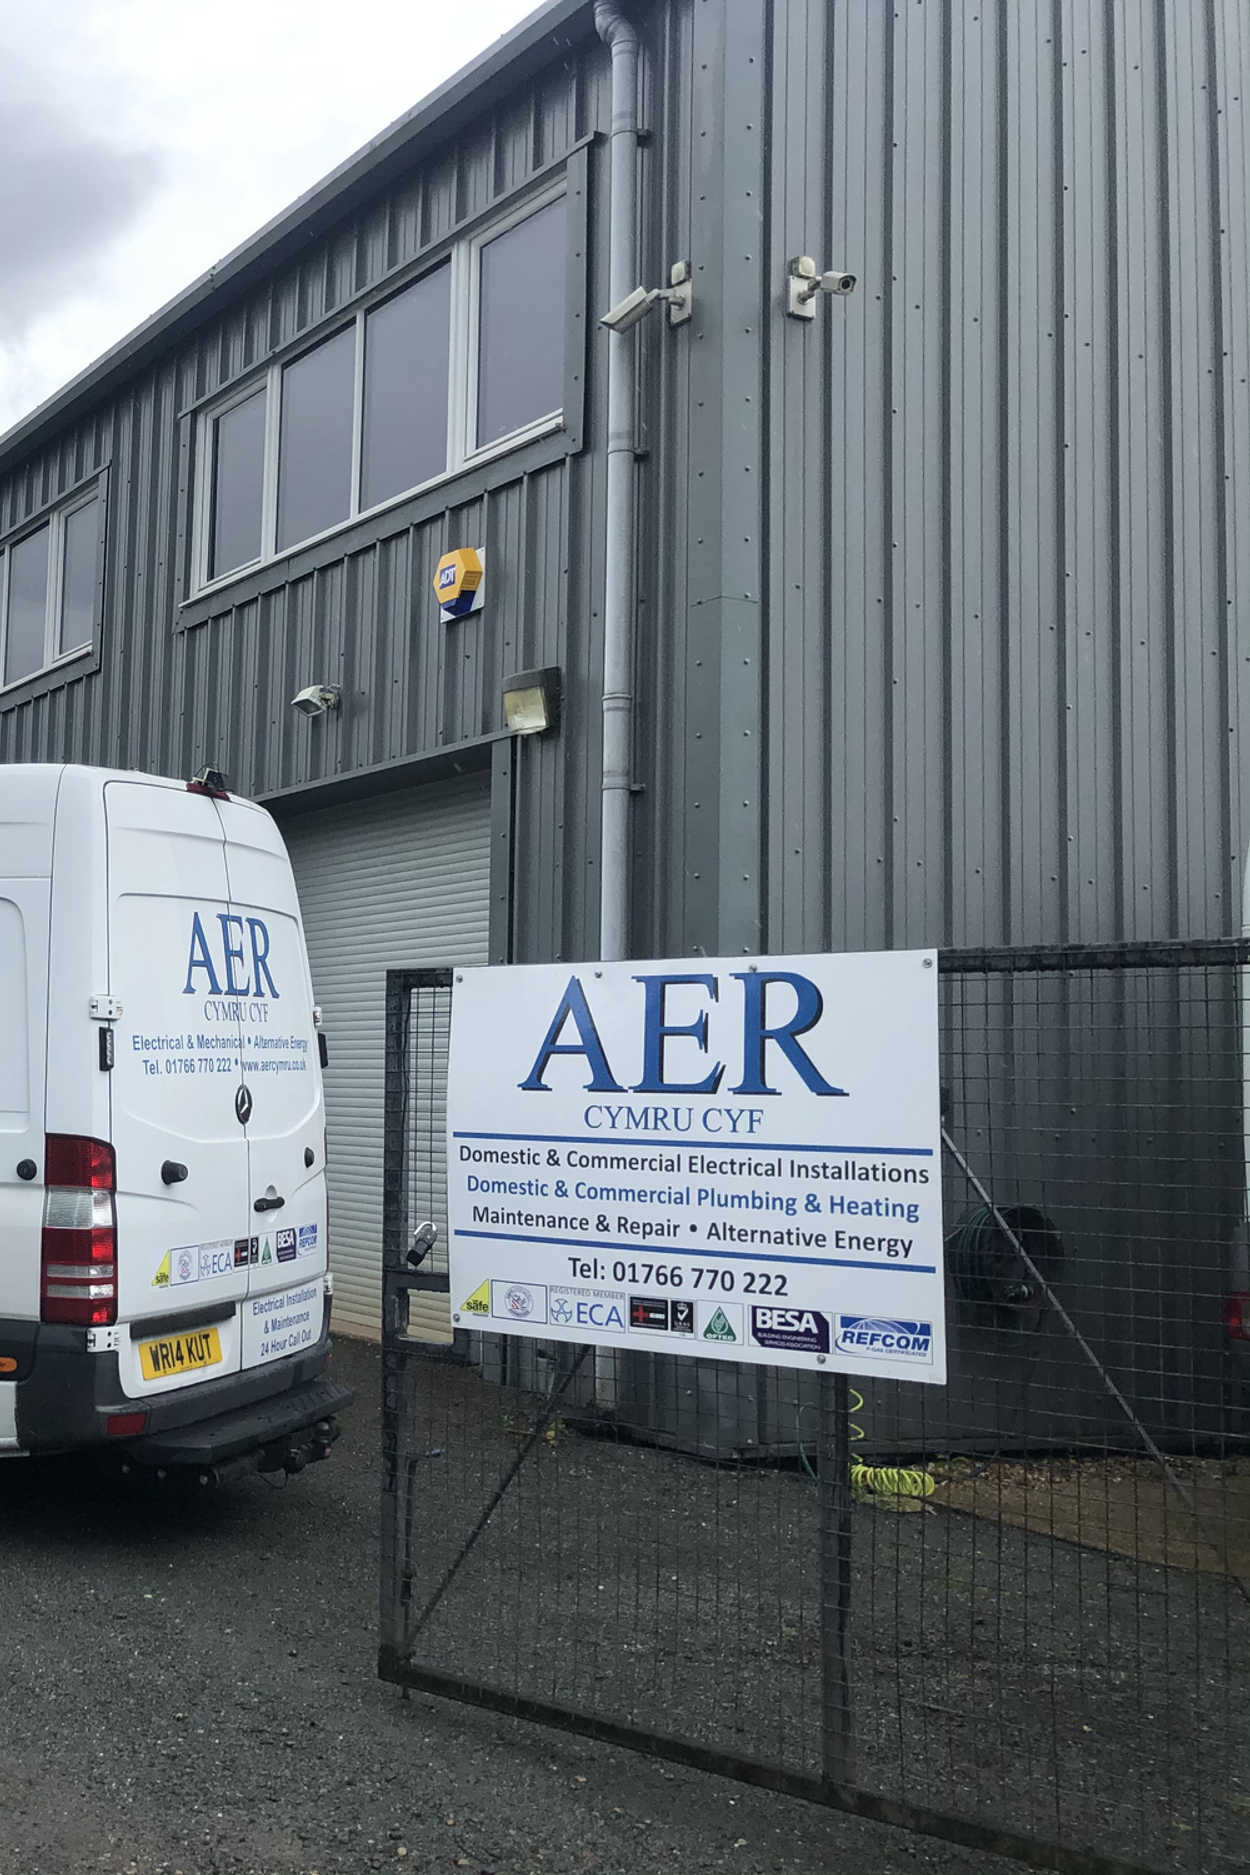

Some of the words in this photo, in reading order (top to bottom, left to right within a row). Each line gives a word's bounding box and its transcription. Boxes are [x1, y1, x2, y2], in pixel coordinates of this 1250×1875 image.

[439, 567, 456, 587] ADT
[182, 911, 280, 998] AER
[204, 1000, 247, 1022] CYMRU
[249, 1002, 269, 1023] CYF
[132, 1034, 183, 1050] Electrical
[187, 1036, 194, 1049] &
[197, 1034, 245, 1049] Mechanical
[254, 1035, 289, 1049] Alternative
[290, 1036, 308, 1052] Energy
[516, 970, 850, 1097] AER
[142, 1059, 162, 1075] Tel.
[165, 1058, 195, 1074] 01766
[198, 1058, 214, 1073] 770
[216, 1057, 231, 1073] 222
[242, 1058, 307, 1074] www.aercymru.co.uk
[583, 1104, 693, 1132] CYMRU
[702, 1107, 764, 1134] CYF
[459, 1145, 540, 1166] Domestic
[546, 1149, 561, 1167] &
[567, 1150, 681, 1173] Commercial
[688, 1155, 782, 1178] Electrical
[790, 1159, 930, 1184] Installations
[467, 1175, 549, 1197] Domestic
[554, 1180, 569, 1198] &
[575, 1182, 690, 1205] Commercial
[697, 1187, 797, 1216] Plumbing
[804, 1193, 822, 1213] &
[830, 1195, 919, 1223] Heating
[278, 1230, 295, 1248] BESA
[472, 1205, 589, 1230] Maintenance
[595, 1214, 610, 1233] &
[617, 1216, 680, 1240] Repair
[706, 1221, 827, 1248] Alternative
[835, 1230, 913, 1258] Energy
[212, 1252, 232, 1273] ECA
[568, 1257, 605, 1280] Tel:
[613, 1261, 683, 1287] 01766
[691, 1267, 735, 1292] 770
[743, 1272, 789, 1296] 222
[253, 1296, 285, 1316] Electrical
[286, 1288, 317, 1309] Installation
[550, 1285, 591, 1297] REGISTERED
[593, 1290, 624, 1300] MEMBER
[466, 1300, 489, 1313] safe
[577, 1302, 624, 1328] ECA
[264, 1322, 270, 1334] &
[271, 1311, 310, 1333] Maintenance
[756, 1308, 818, 1334] BESA
[149, 1338, 185, 1372] WR14
[186, 1333, 212, 1364] KUT
[260, 1343, 269, 1356] 24
[271, 1337, 287, 1353] Hour
[288, 1332, 300, 1348] Call
[301, 1329, 312, 1343] Out
[841, 1331, 930, 1352] REFCOM
